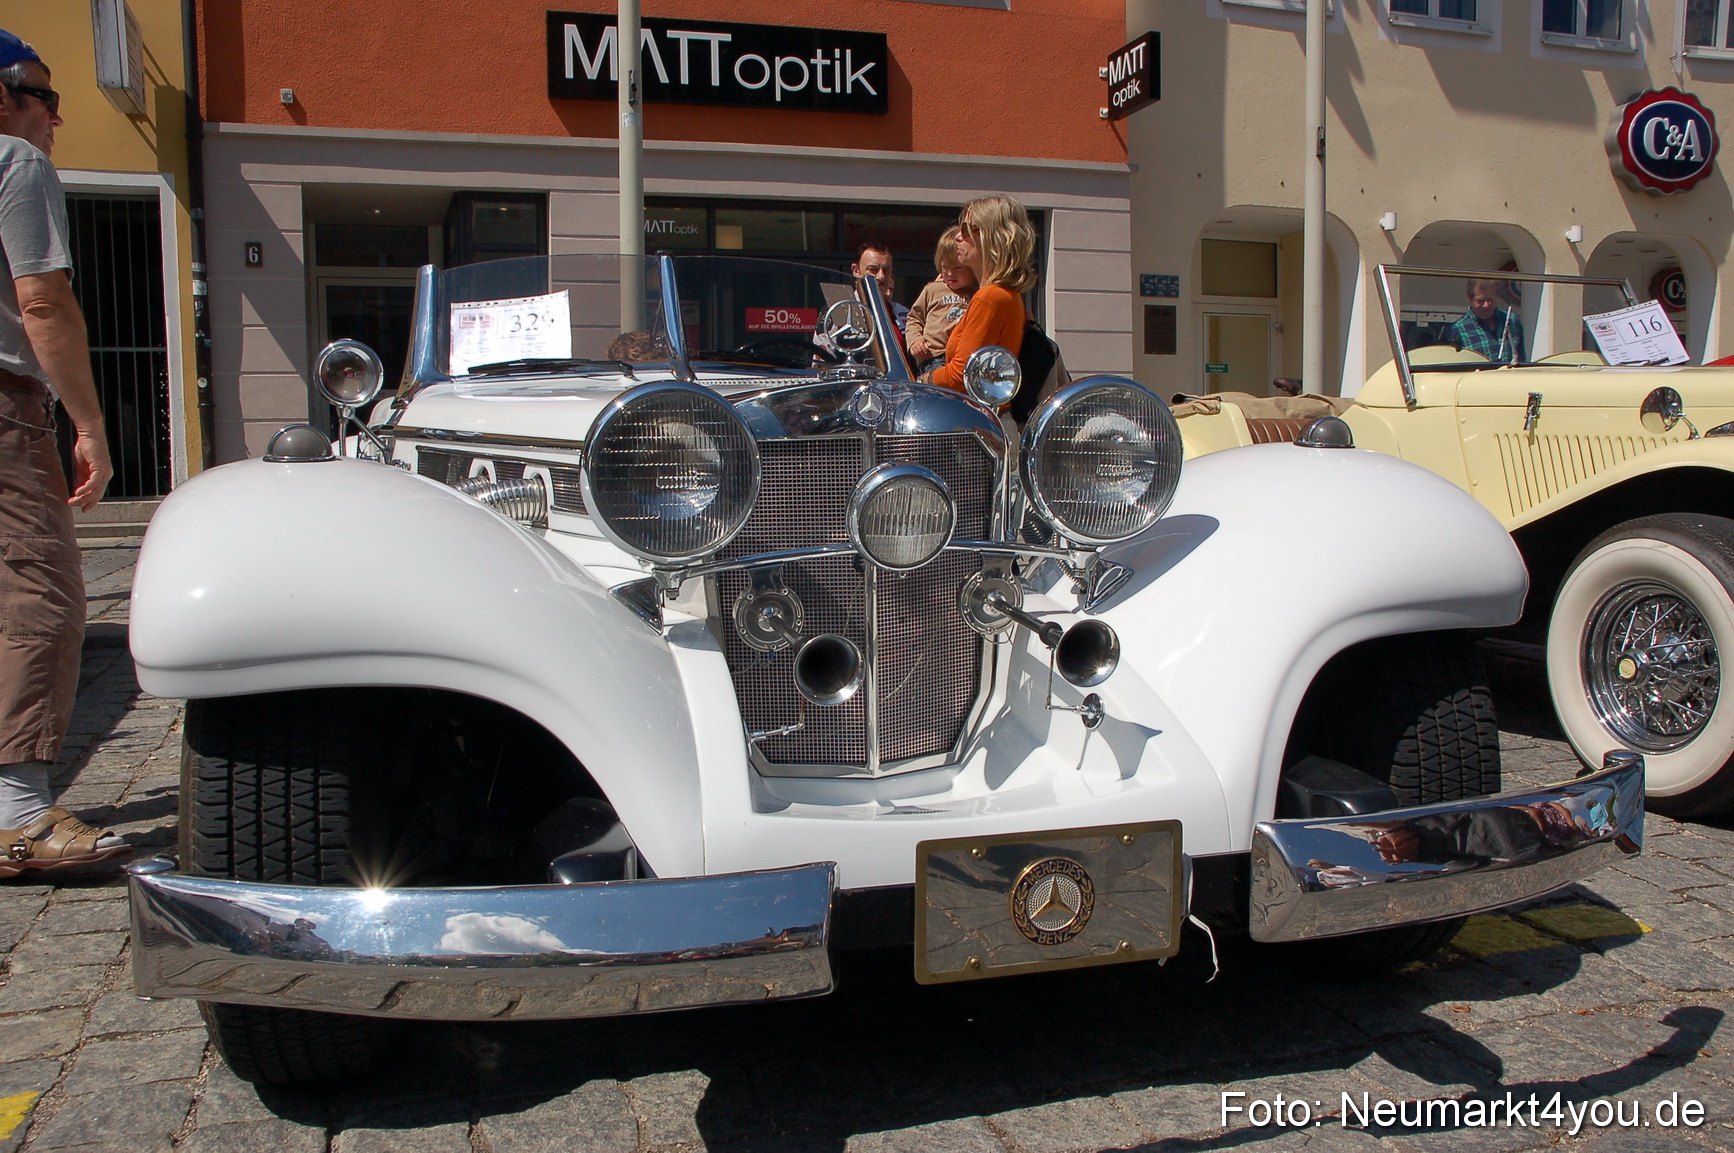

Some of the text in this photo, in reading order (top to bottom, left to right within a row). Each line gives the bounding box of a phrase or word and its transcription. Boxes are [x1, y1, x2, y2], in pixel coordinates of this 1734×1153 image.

[733, 47, 878, 102] optik
[1108, 41, 1147, 86] MATT
[1112, 78, 1141, 108] optik
[1643, 116, 1704, 162] C&A
[674, 225, 699, 236] optik
[248, 246, 259, 263] 6
[764, 309, 801, 324] 50%
[1628, 314, 1663, 338] 116
[1025, 860, 1084, 886] MERCEDES
[1037, 928, 1071, 945] BENZ
